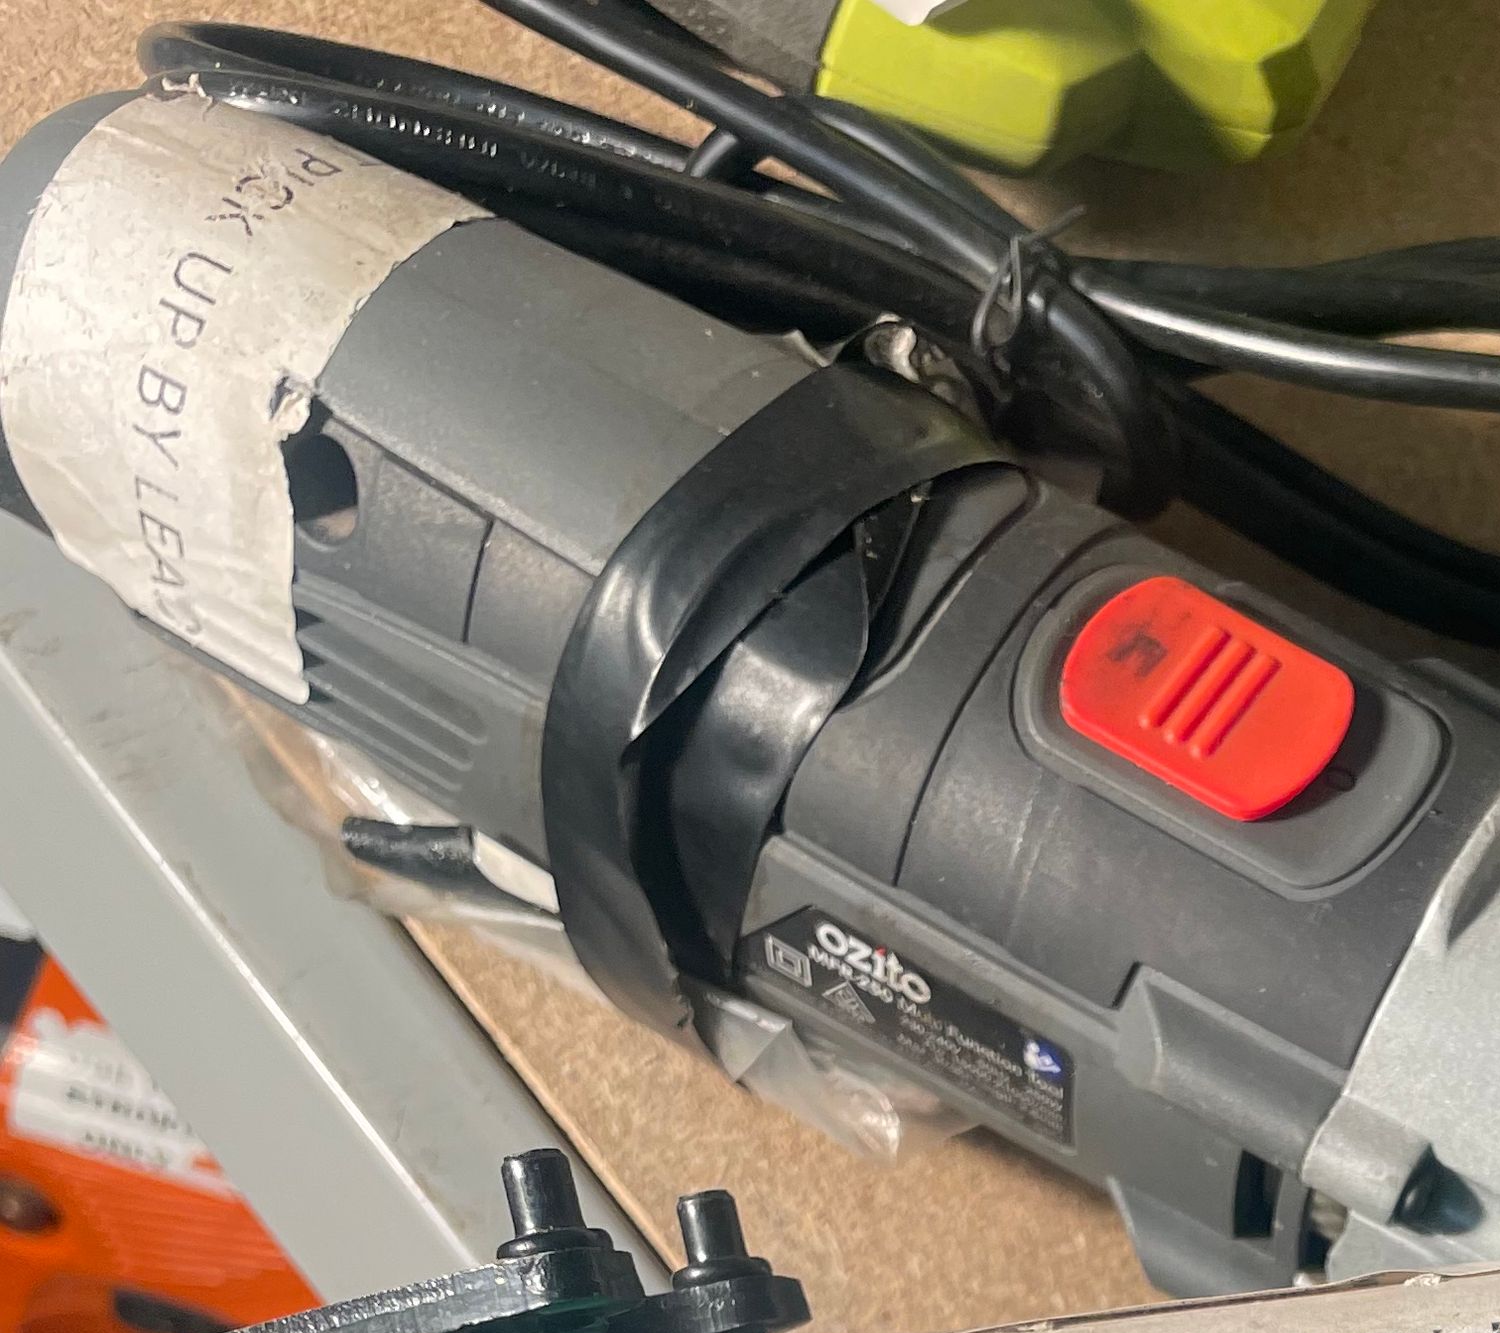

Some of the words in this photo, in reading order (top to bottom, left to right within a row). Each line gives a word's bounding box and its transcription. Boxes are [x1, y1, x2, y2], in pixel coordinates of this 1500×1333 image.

[202, 147, 343, 237] PICK
[158, 250, 235, 352] UP
[131, 363, 188, 471] BY
[815, 920, 932, 1005] ozito
